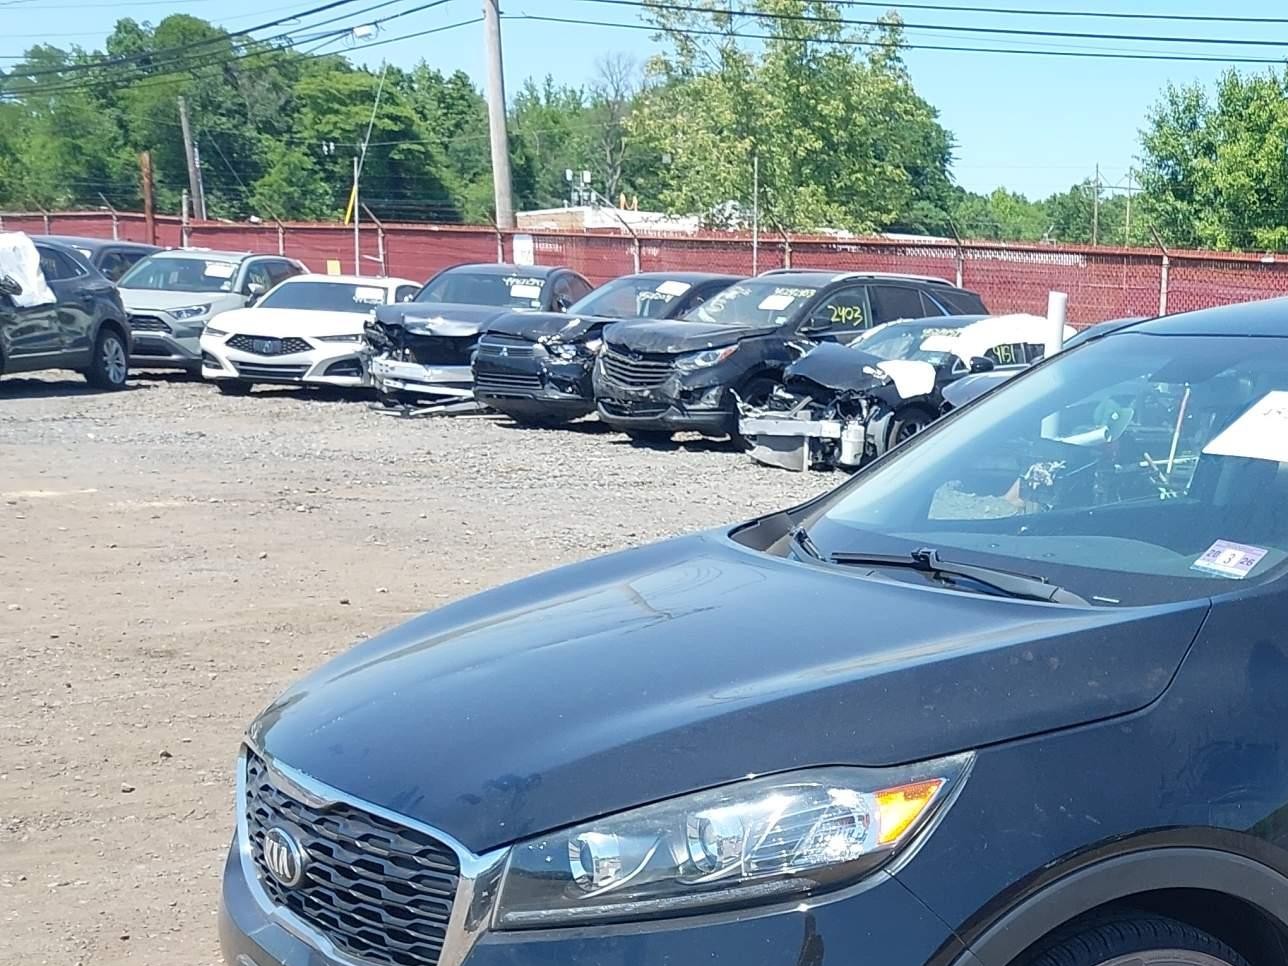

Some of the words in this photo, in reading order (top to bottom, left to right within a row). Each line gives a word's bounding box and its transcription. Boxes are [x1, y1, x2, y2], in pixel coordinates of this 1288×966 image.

[827, 304, 863, 327] 2403
[1223, 553, 1236, 564] 3
[1240, 557, 1256, 566] 26
